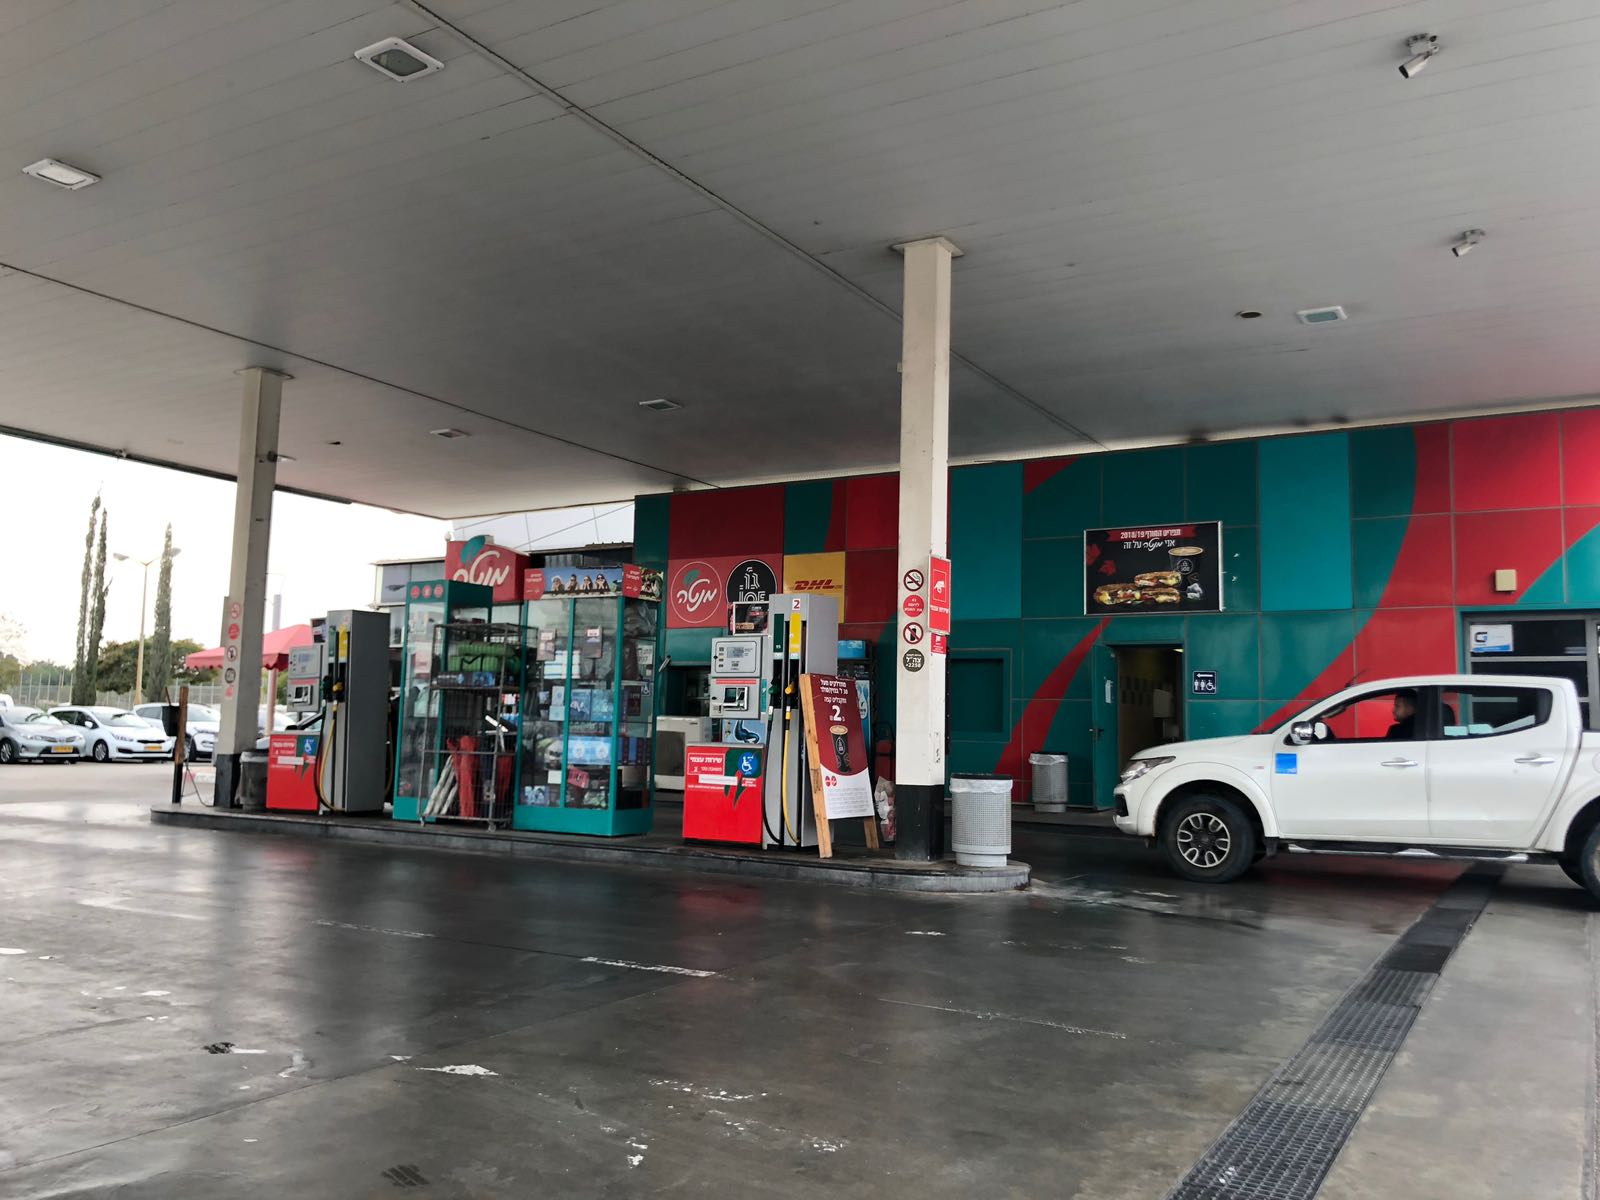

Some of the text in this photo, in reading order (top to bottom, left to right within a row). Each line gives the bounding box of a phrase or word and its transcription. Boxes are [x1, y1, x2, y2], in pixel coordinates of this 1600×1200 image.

[795, 579, 834, 590] DHL
[676, 578, 717, 612] מנטה
[793, 599, 800, 609] 2
